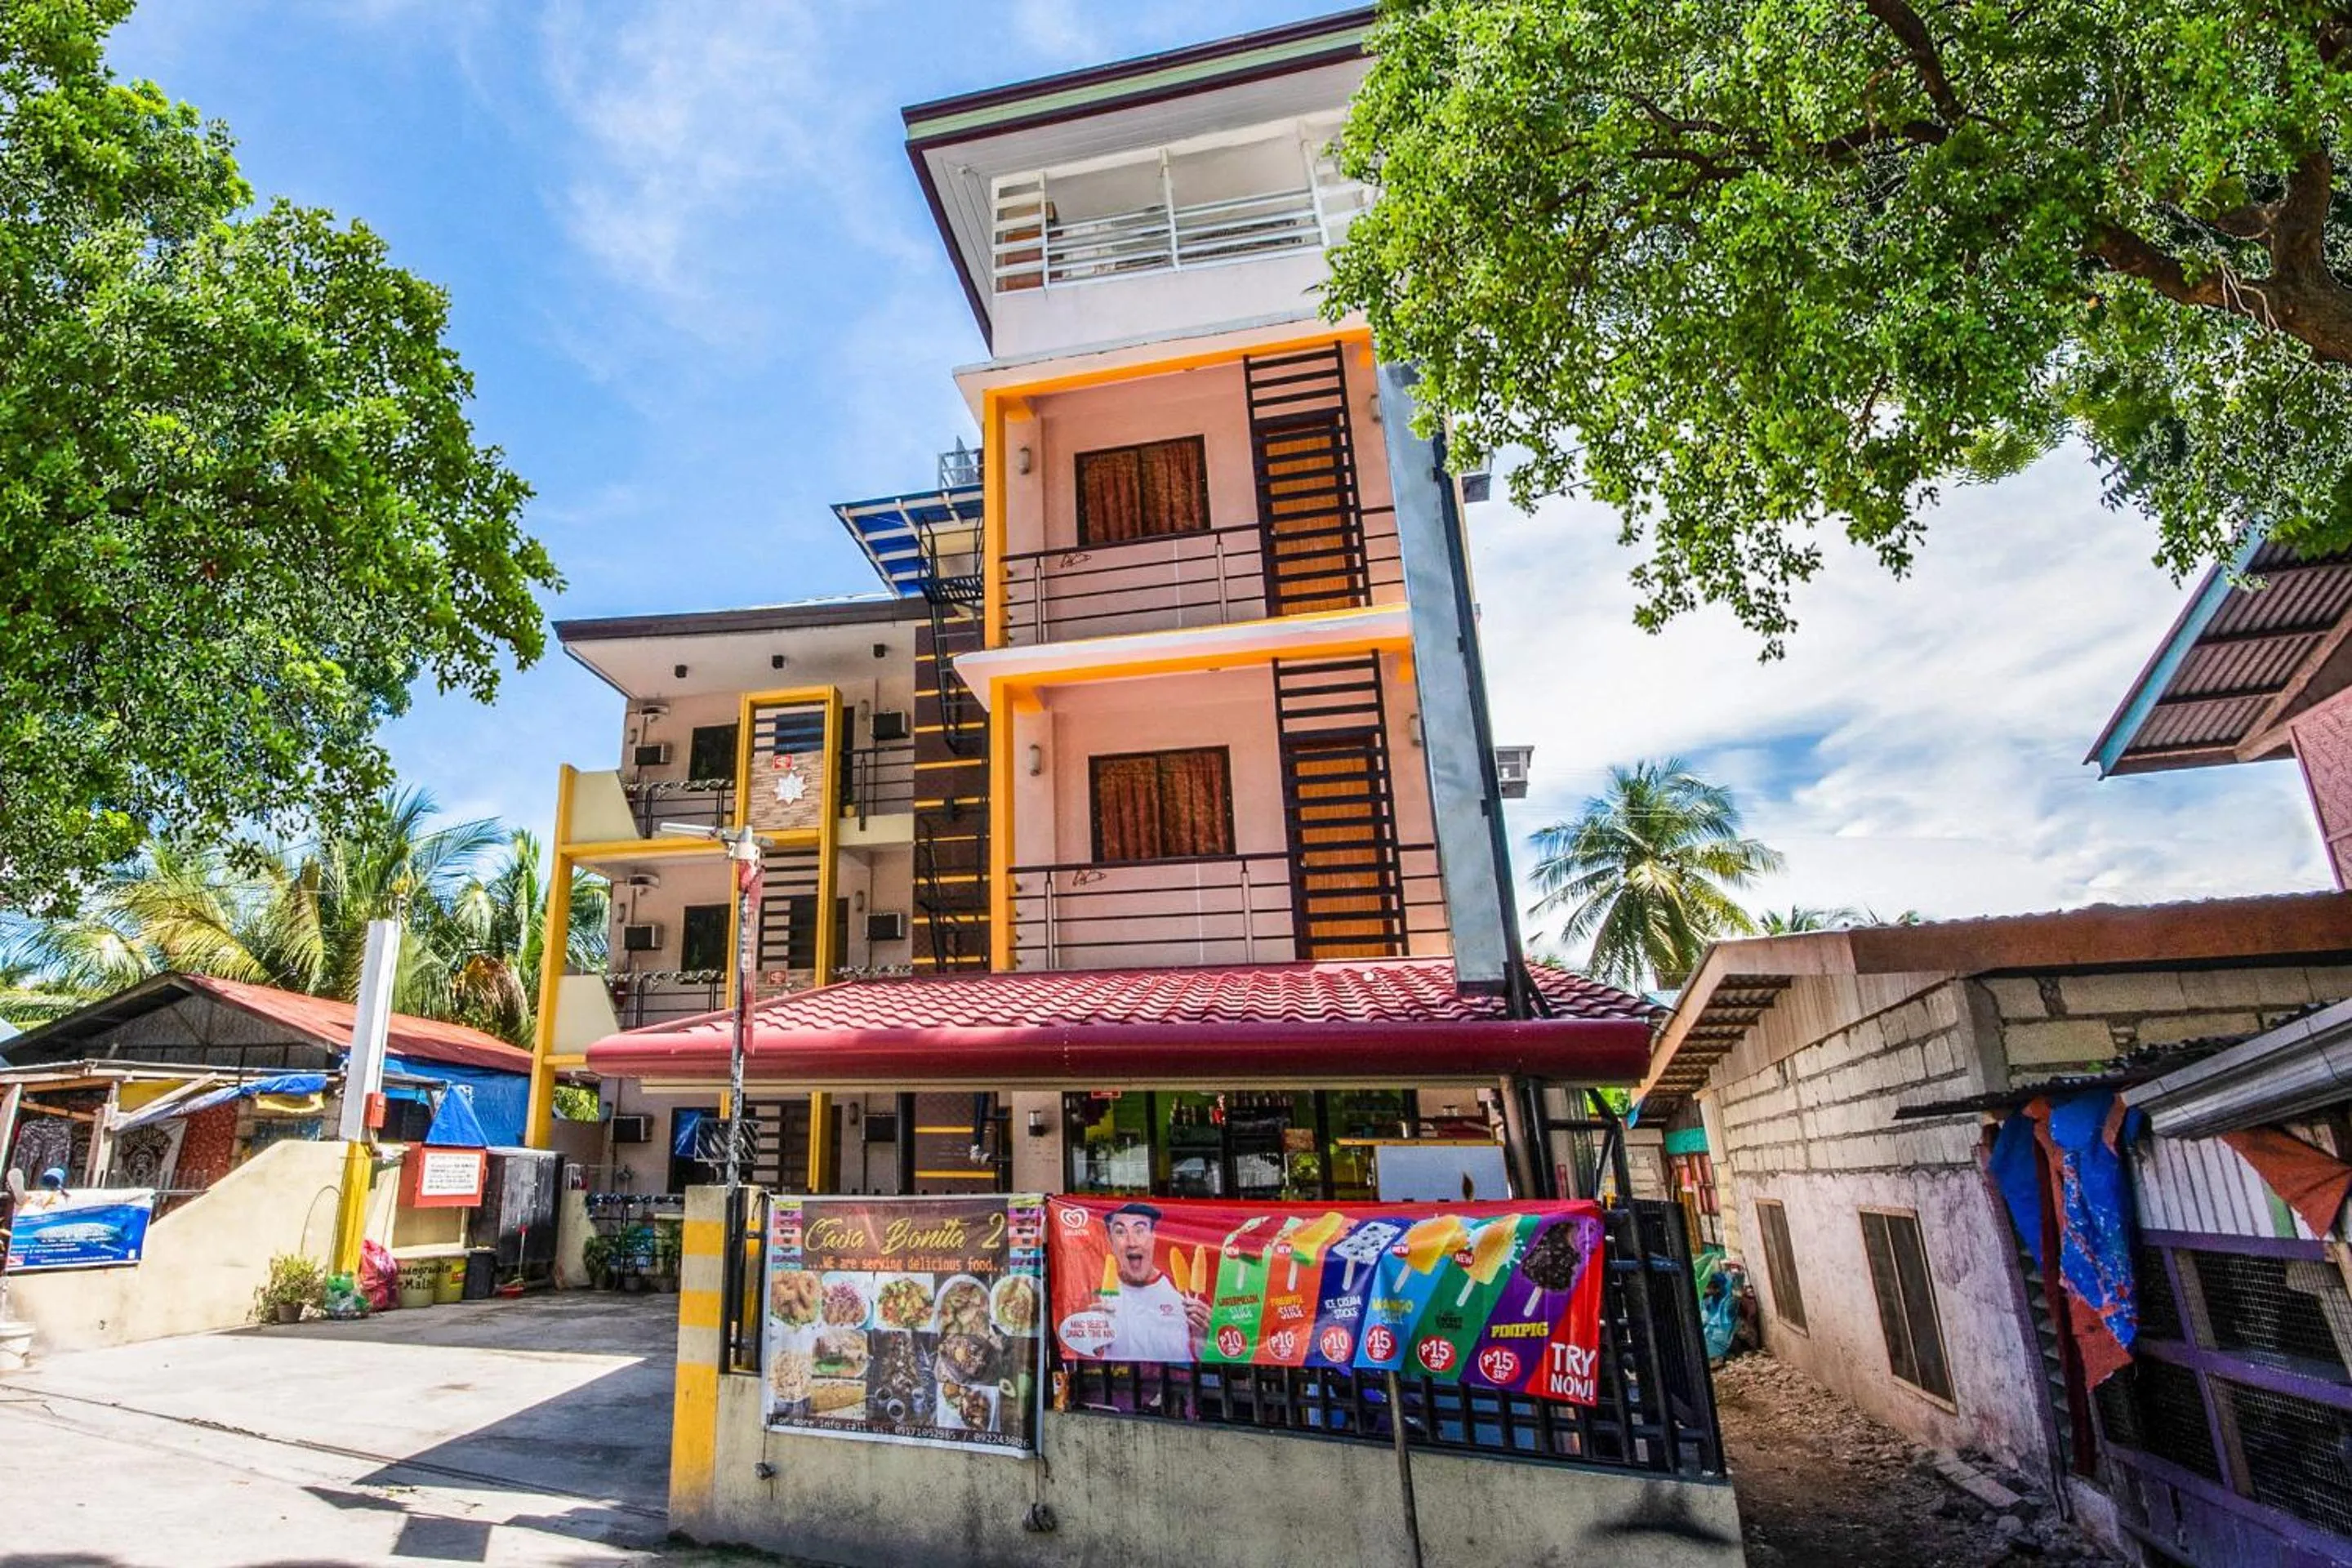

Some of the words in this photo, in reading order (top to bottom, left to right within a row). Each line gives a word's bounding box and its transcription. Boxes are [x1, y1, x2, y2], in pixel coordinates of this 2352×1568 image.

[805, 1218, 866, 1251] Casa
[880, 1218, 970, 1255] Bonita
[982, 1213, 1005, 1249] 2
[840, 1258, 857, 1269] are
[862, 1257, 902, 1272] serving
[907, 1256, 961, 1271] delicious
[1454, 1252, 1472, 1266] NEW
[1337, 1295, 1361, 1307] CREAM
[1372, 1298, 1414, 1313] MANGO
[1490, 1322, 1549, 1338] PINIPIG
[1551, 1343, 1596, 1377] TRY
[1551, 1374, 1593, 1401] NOW!
